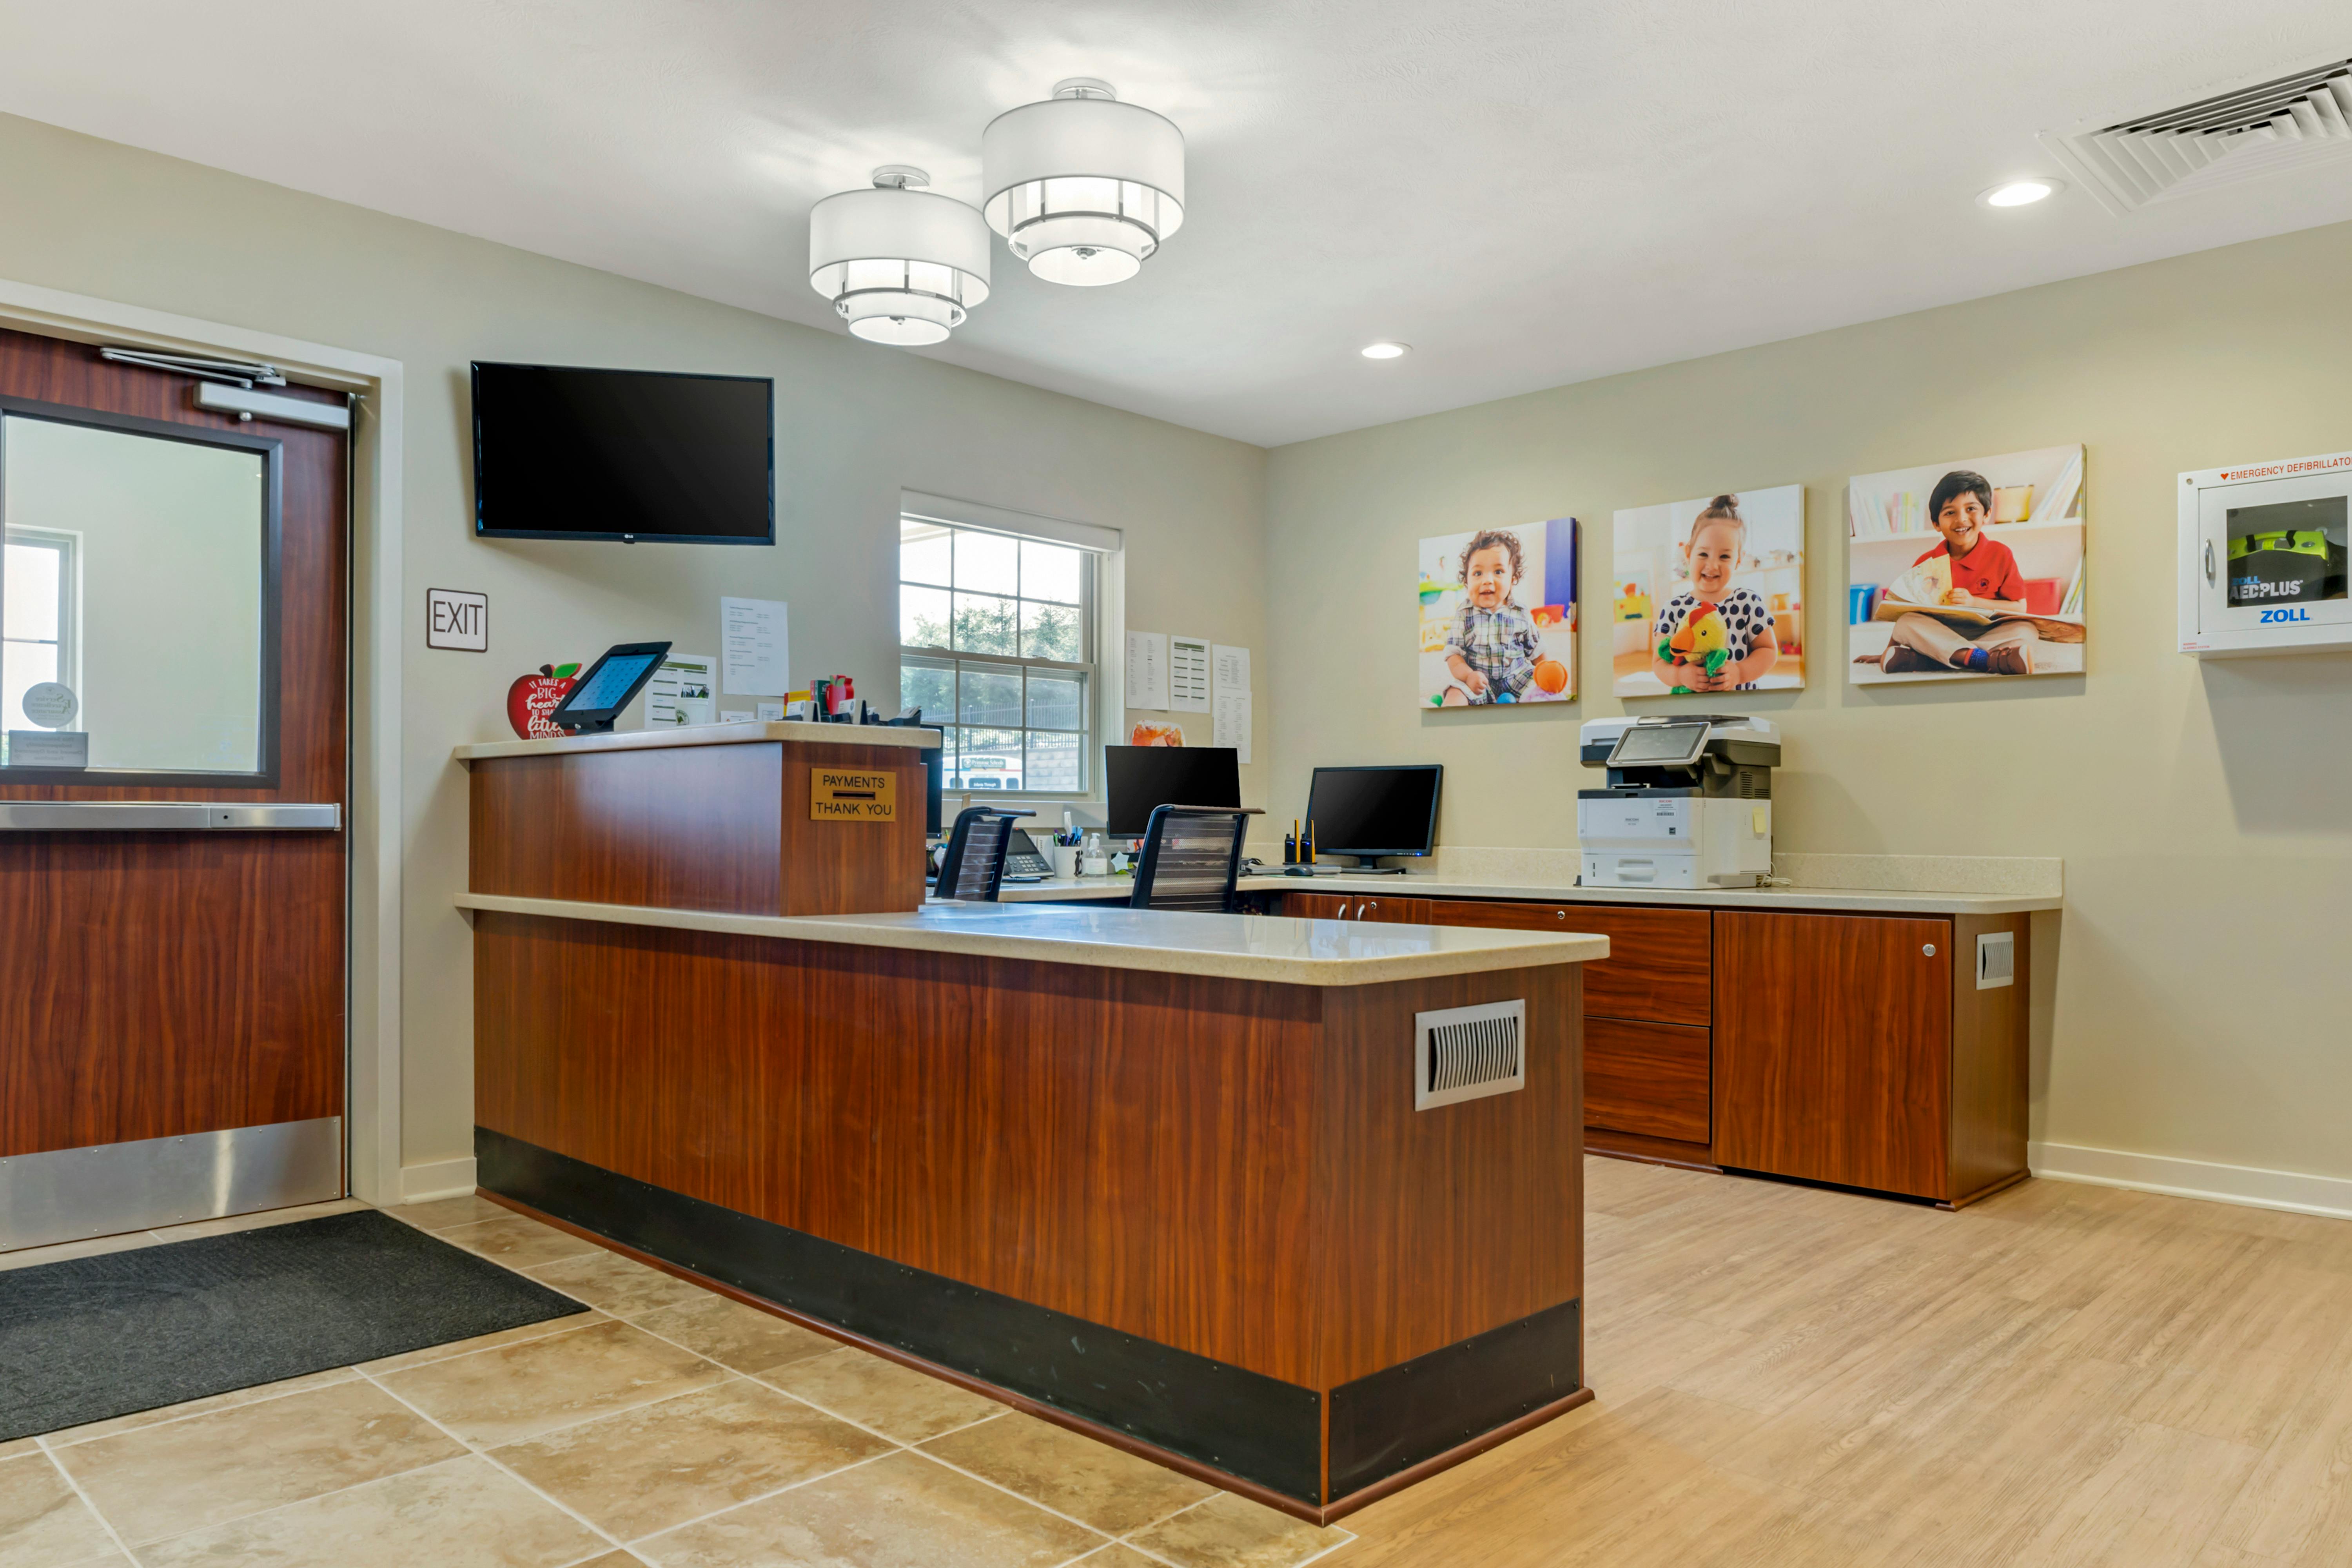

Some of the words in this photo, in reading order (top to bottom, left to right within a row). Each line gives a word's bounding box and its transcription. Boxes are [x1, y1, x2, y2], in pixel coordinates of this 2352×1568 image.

[2231, 466, 2284, 480] EMERGENCY
[2232, 575, 2261, 585] ZOLL
[434, 601, 483, 635] EXIT
[2260, 608, 2310, 623] ZOLL
[529, 681, 537, 689] IT
[537, 687, 556, 699] BIG
[823, 775, 885, 788] PAYMENTS
[815, 802, 860, 815] THANK
[866, 804, 891, 815] YOU
